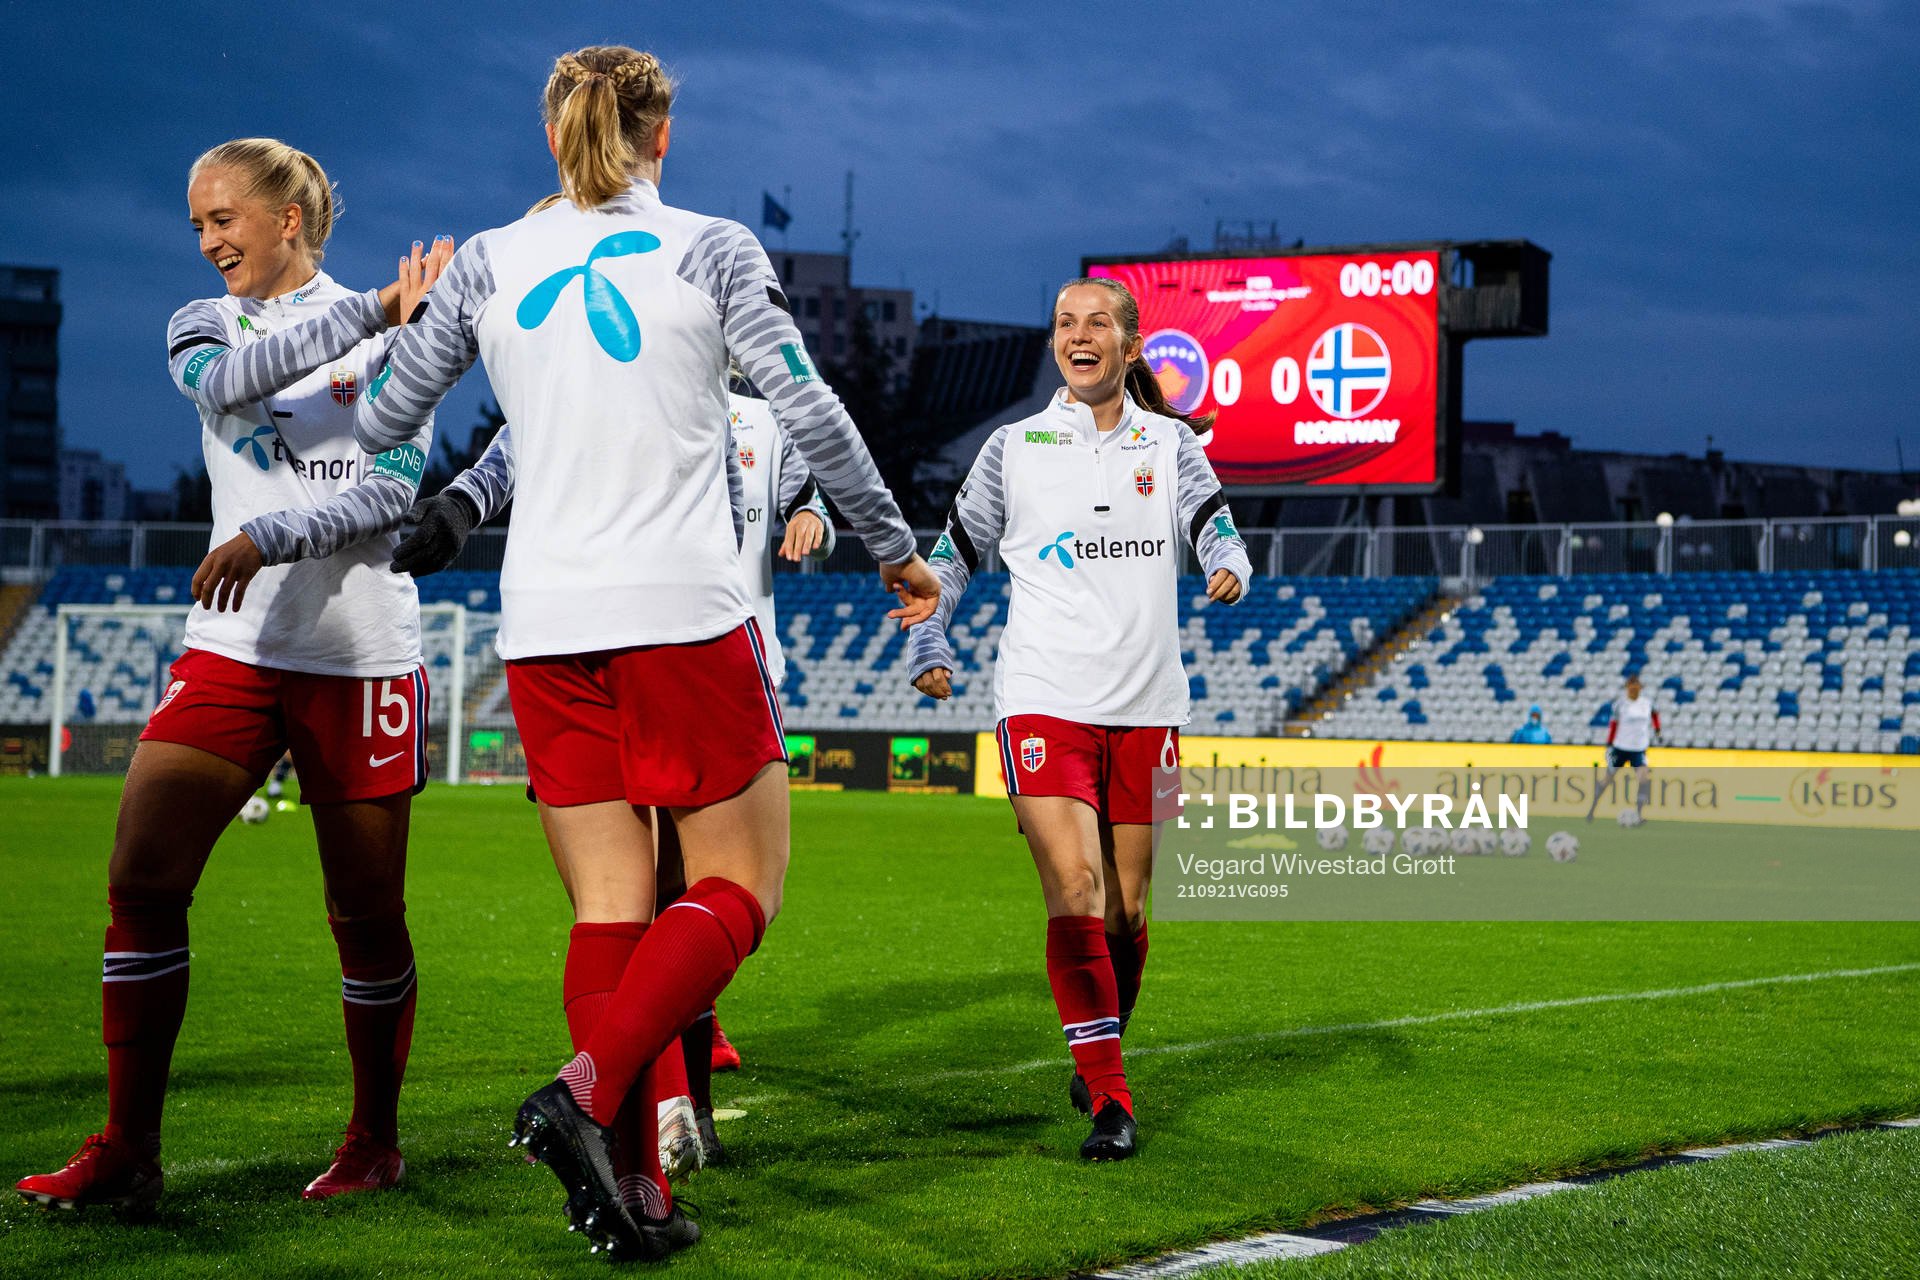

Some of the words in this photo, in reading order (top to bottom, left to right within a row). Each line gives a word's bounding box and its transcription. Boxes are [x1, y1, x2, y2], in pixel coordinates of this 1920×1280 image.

[1340, 260, 1434, 298] 00:00
[1212, 358, 1242, 406] 0
[1270, 356, 1300, 405] 0
[1025, 430, 1058, 445] KIWI
[1294, 419, 1400, 445] NORWAY
[390, 447, 421, 472] DNB
[1074, 536, 1166, 560] telenor
[362, 676, 410, 737] 15
[1160, 727, 1178, 775] 6
[1186, 752, 1324, 795] shtina
[1803, 782, 1898, 809] KEDS
